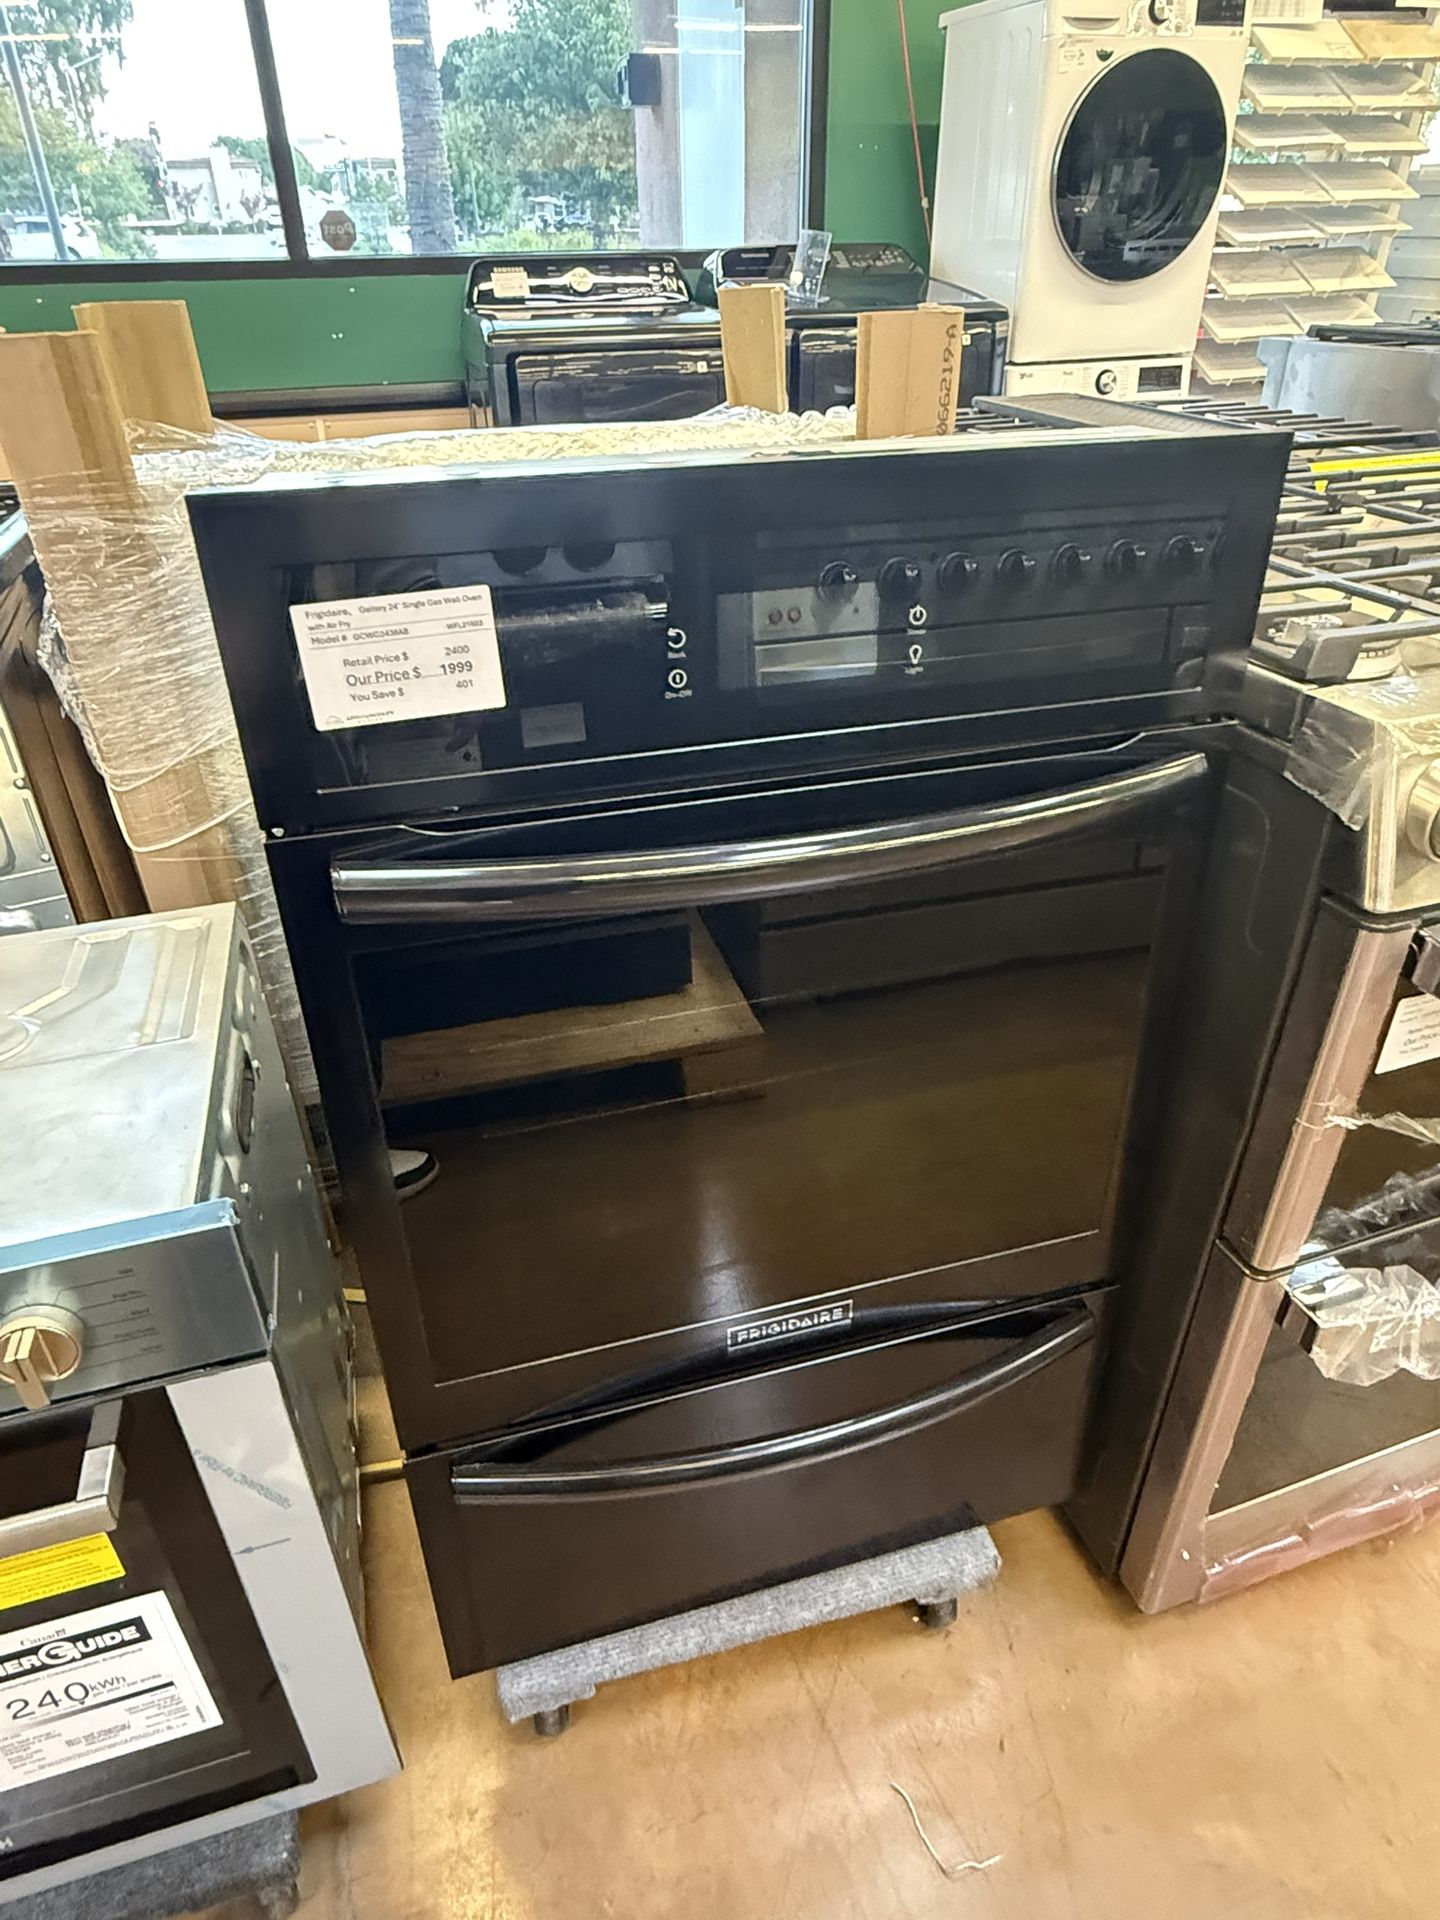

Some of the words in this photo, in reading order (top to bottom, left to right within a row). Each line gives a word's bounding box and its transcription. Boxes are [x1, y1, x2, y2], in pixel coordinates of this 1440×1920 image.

[402, 600, 426, 610] Single
[310, 634, 340, 645] Model
[444, 644, 470, 656] 2400
[343, 656, 373, 668] Retail
[374, 654, 400, 664] Price
[401, 651, 409, 662] $
[440, 660, 473, 676] 1999
[346, 673, 371, 687] Our
[374, 669, 410, 683] Price
[412, 666, 422, 679] $
[456, 679, 474, 689] 401
[349, 692, 370, 702] You
[371, 690, 396, 700] Save
[398, 687, 405, 697] $
[736, 1307, 844, 1343] FRIGIDAIRE
[6, 1681, 90, 1721] 240
[89, 1676, 127, 1692] kWh
